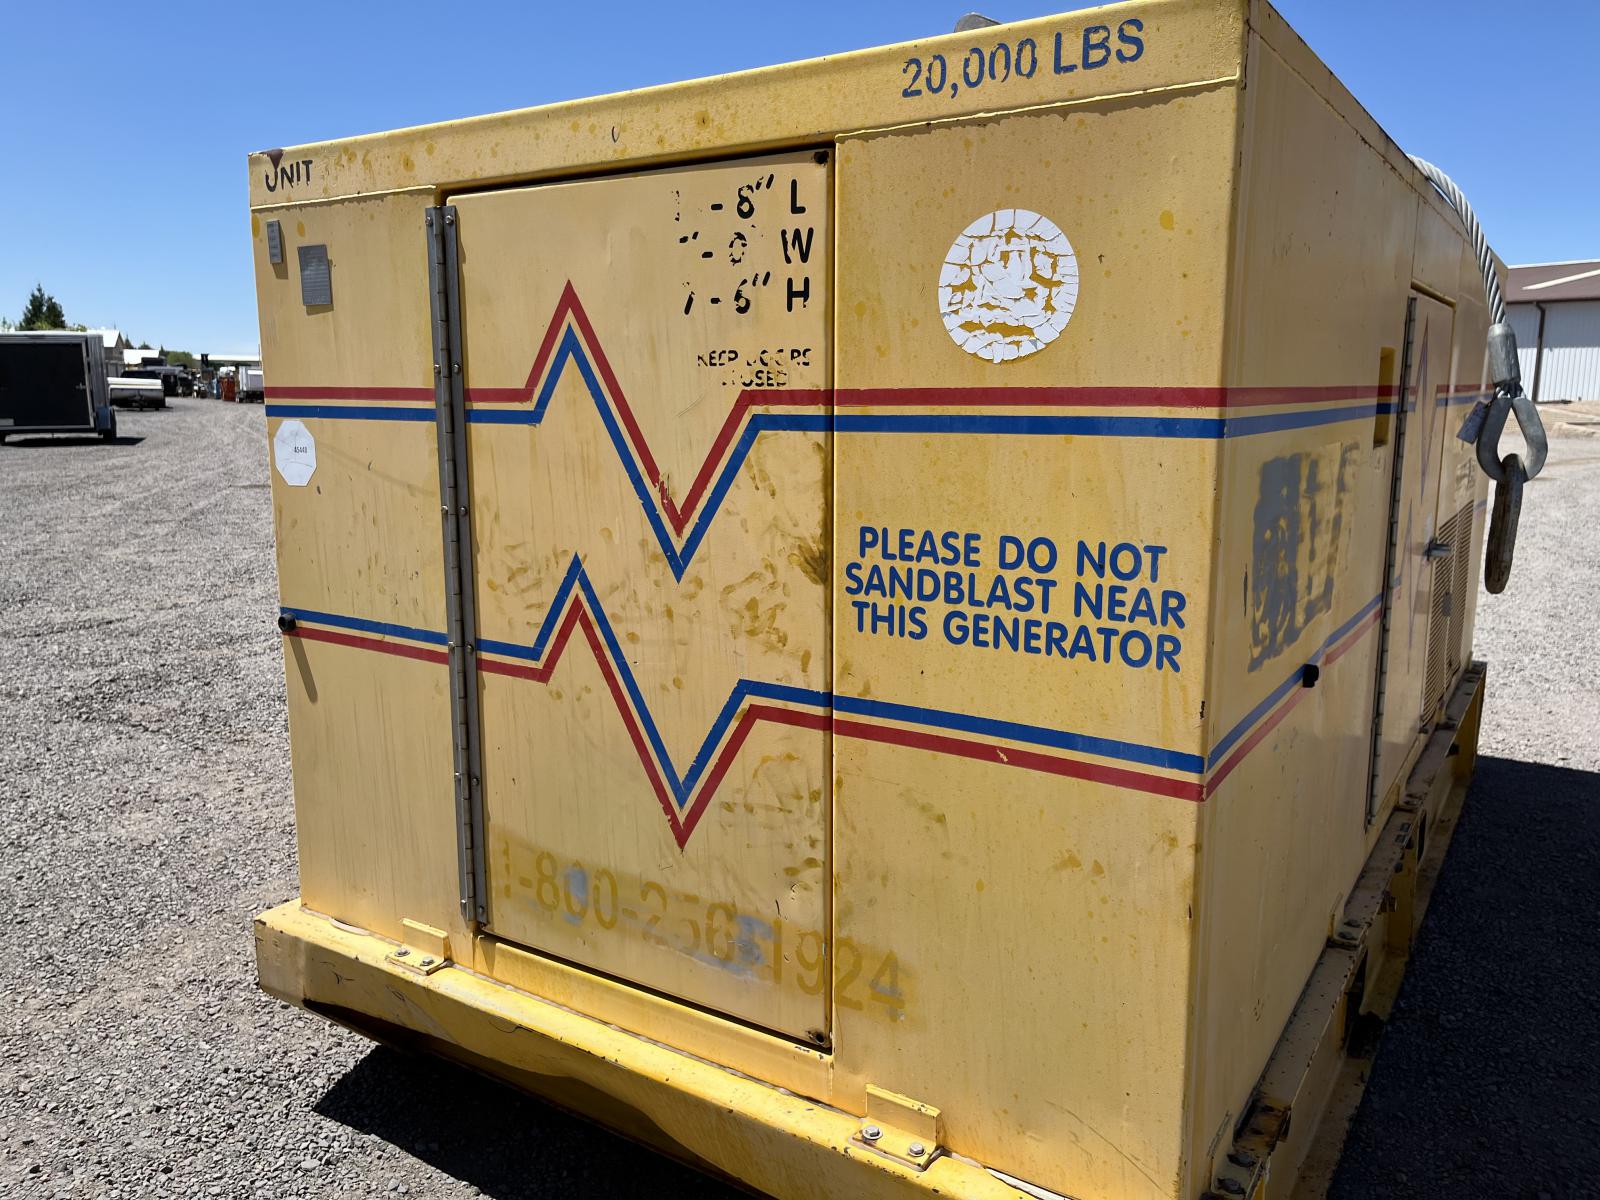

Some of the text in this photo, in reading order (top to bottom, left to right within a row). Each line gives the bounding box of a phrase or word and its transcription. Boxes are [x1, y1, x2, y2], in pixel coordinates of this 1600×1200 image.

[902, 19, 1144, 98] 20,000 LBS
[265, 160, 313, 193] UNIT
[790, 179, 806, 214] L
[781, 227, 814, 264] W
[786, 277, 810, 312] H
[859, 526, 1168, 583] PLEASE DO NOT
[845, 562, 1187, 630] SANDBLAST NEAR
[851, 600, 1182, 673] THIS GENERATOR
